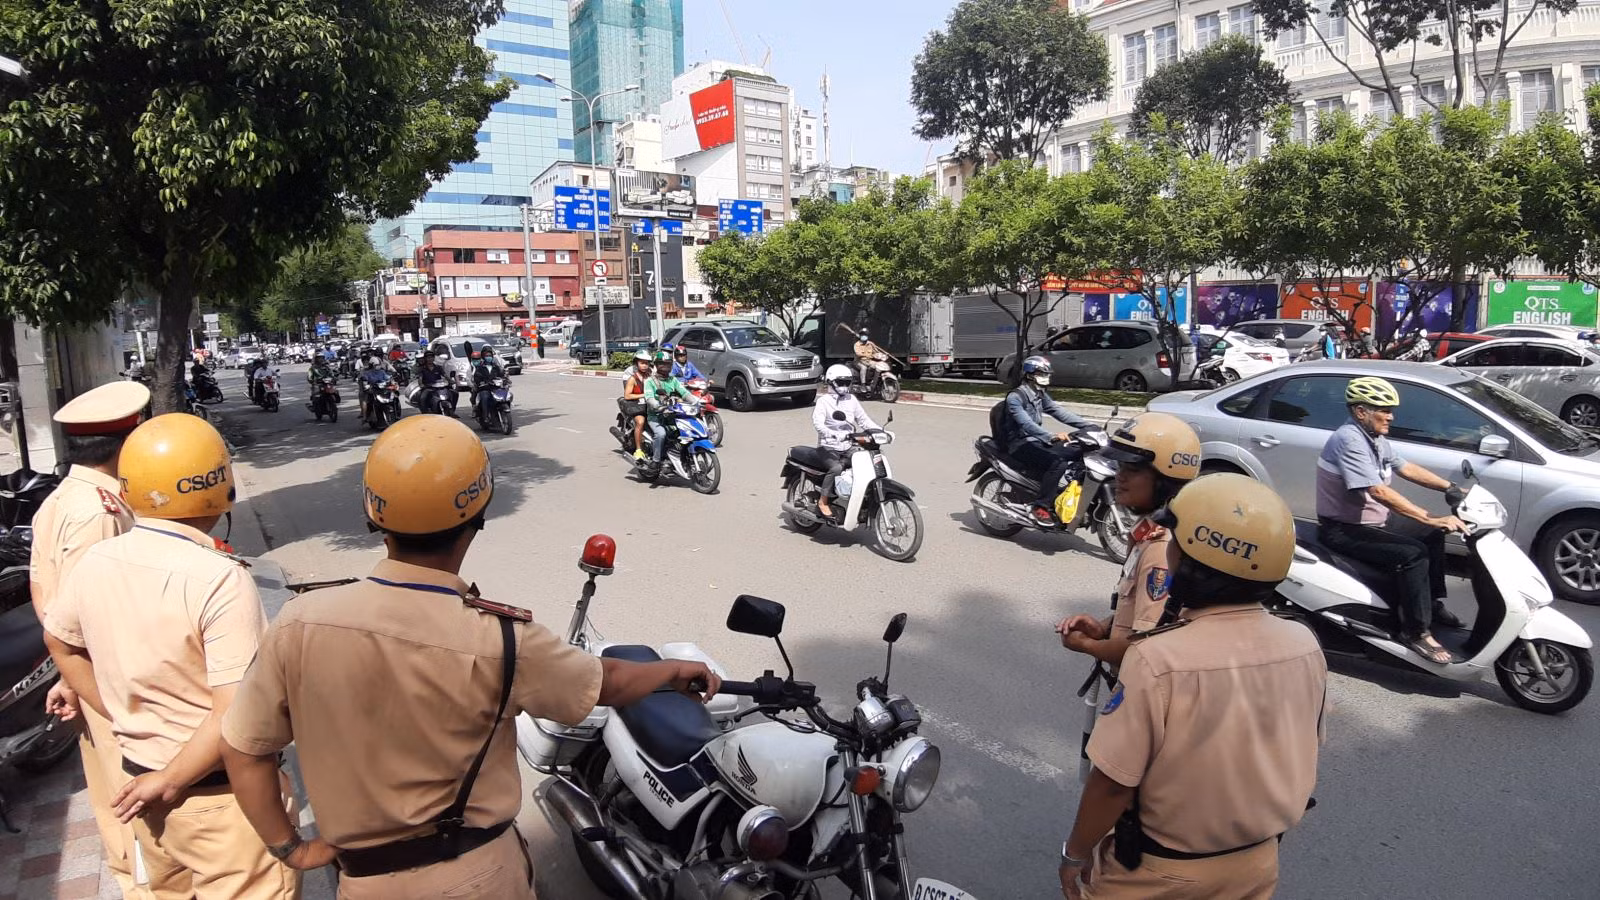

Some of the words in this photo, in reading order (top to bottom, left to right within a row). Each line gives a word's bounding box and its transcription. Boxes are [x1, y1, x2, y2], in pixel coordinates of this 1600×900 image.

[1310, 296, 1339, 310] QS
[1524, 296, 1560, 312] QTS
[1513, 311, 1572, 325] ENGLISH
[1171, 452, 1200, 467] CSG
[176, 466, 227, 494] CSGT
[454, 471, 489, 510] CSG
[1194, 525, 1258, 561] CSGT
[643, 770, 675, 809] POLICE
[731, 771, 757, 796] HONDA
